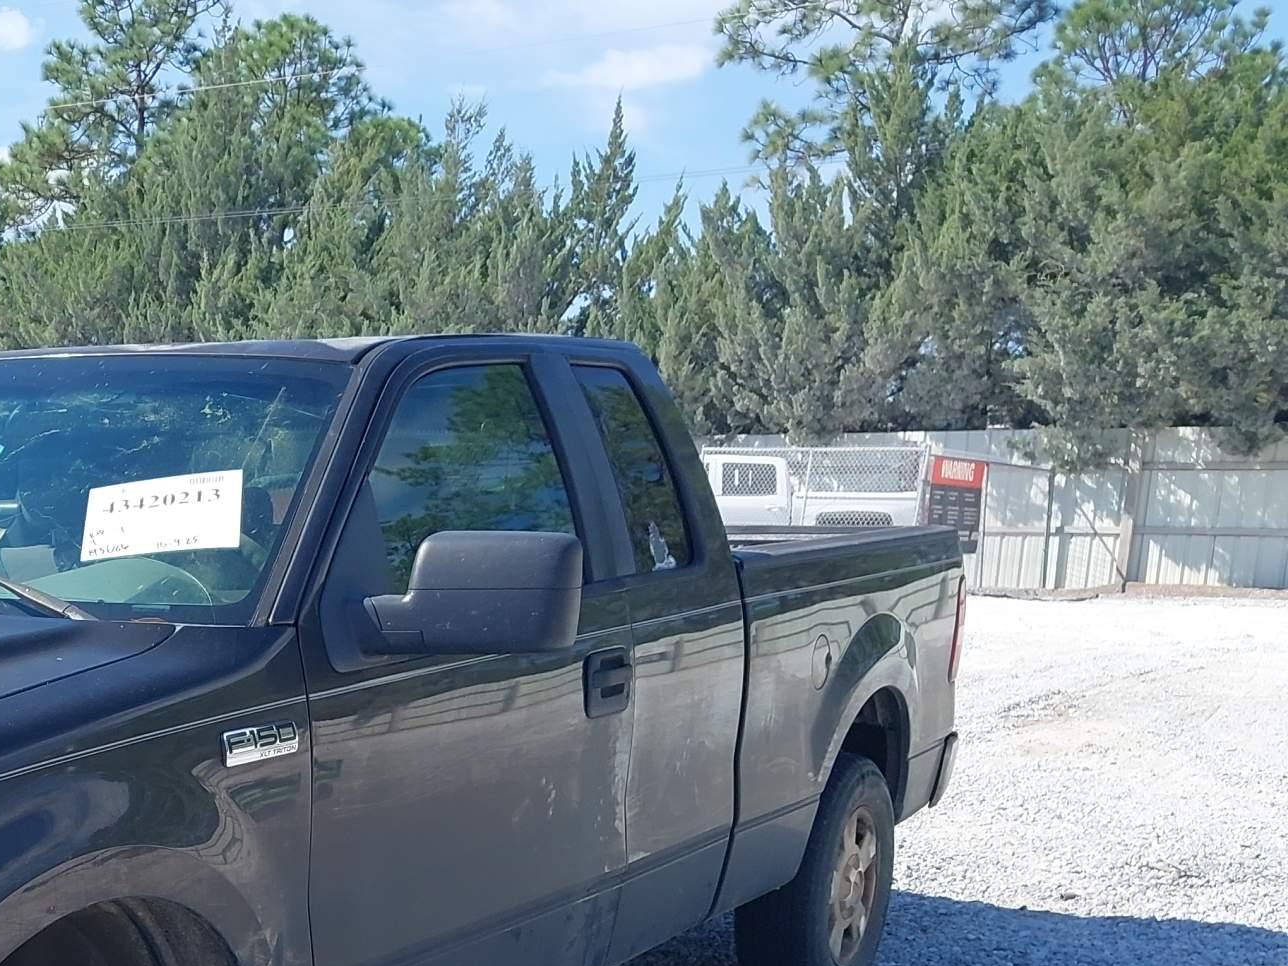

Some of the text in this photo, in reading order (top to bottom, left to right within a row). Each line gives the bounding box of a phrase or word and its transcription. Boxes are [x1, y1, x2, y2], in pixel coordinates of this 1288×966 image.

[941, 459, 976, 482] WARNING
[103, 488, 221, 514] 43420213
[226, 722, 297, 754] F-150
[259, 744, 297, 758] XLT TRITON
